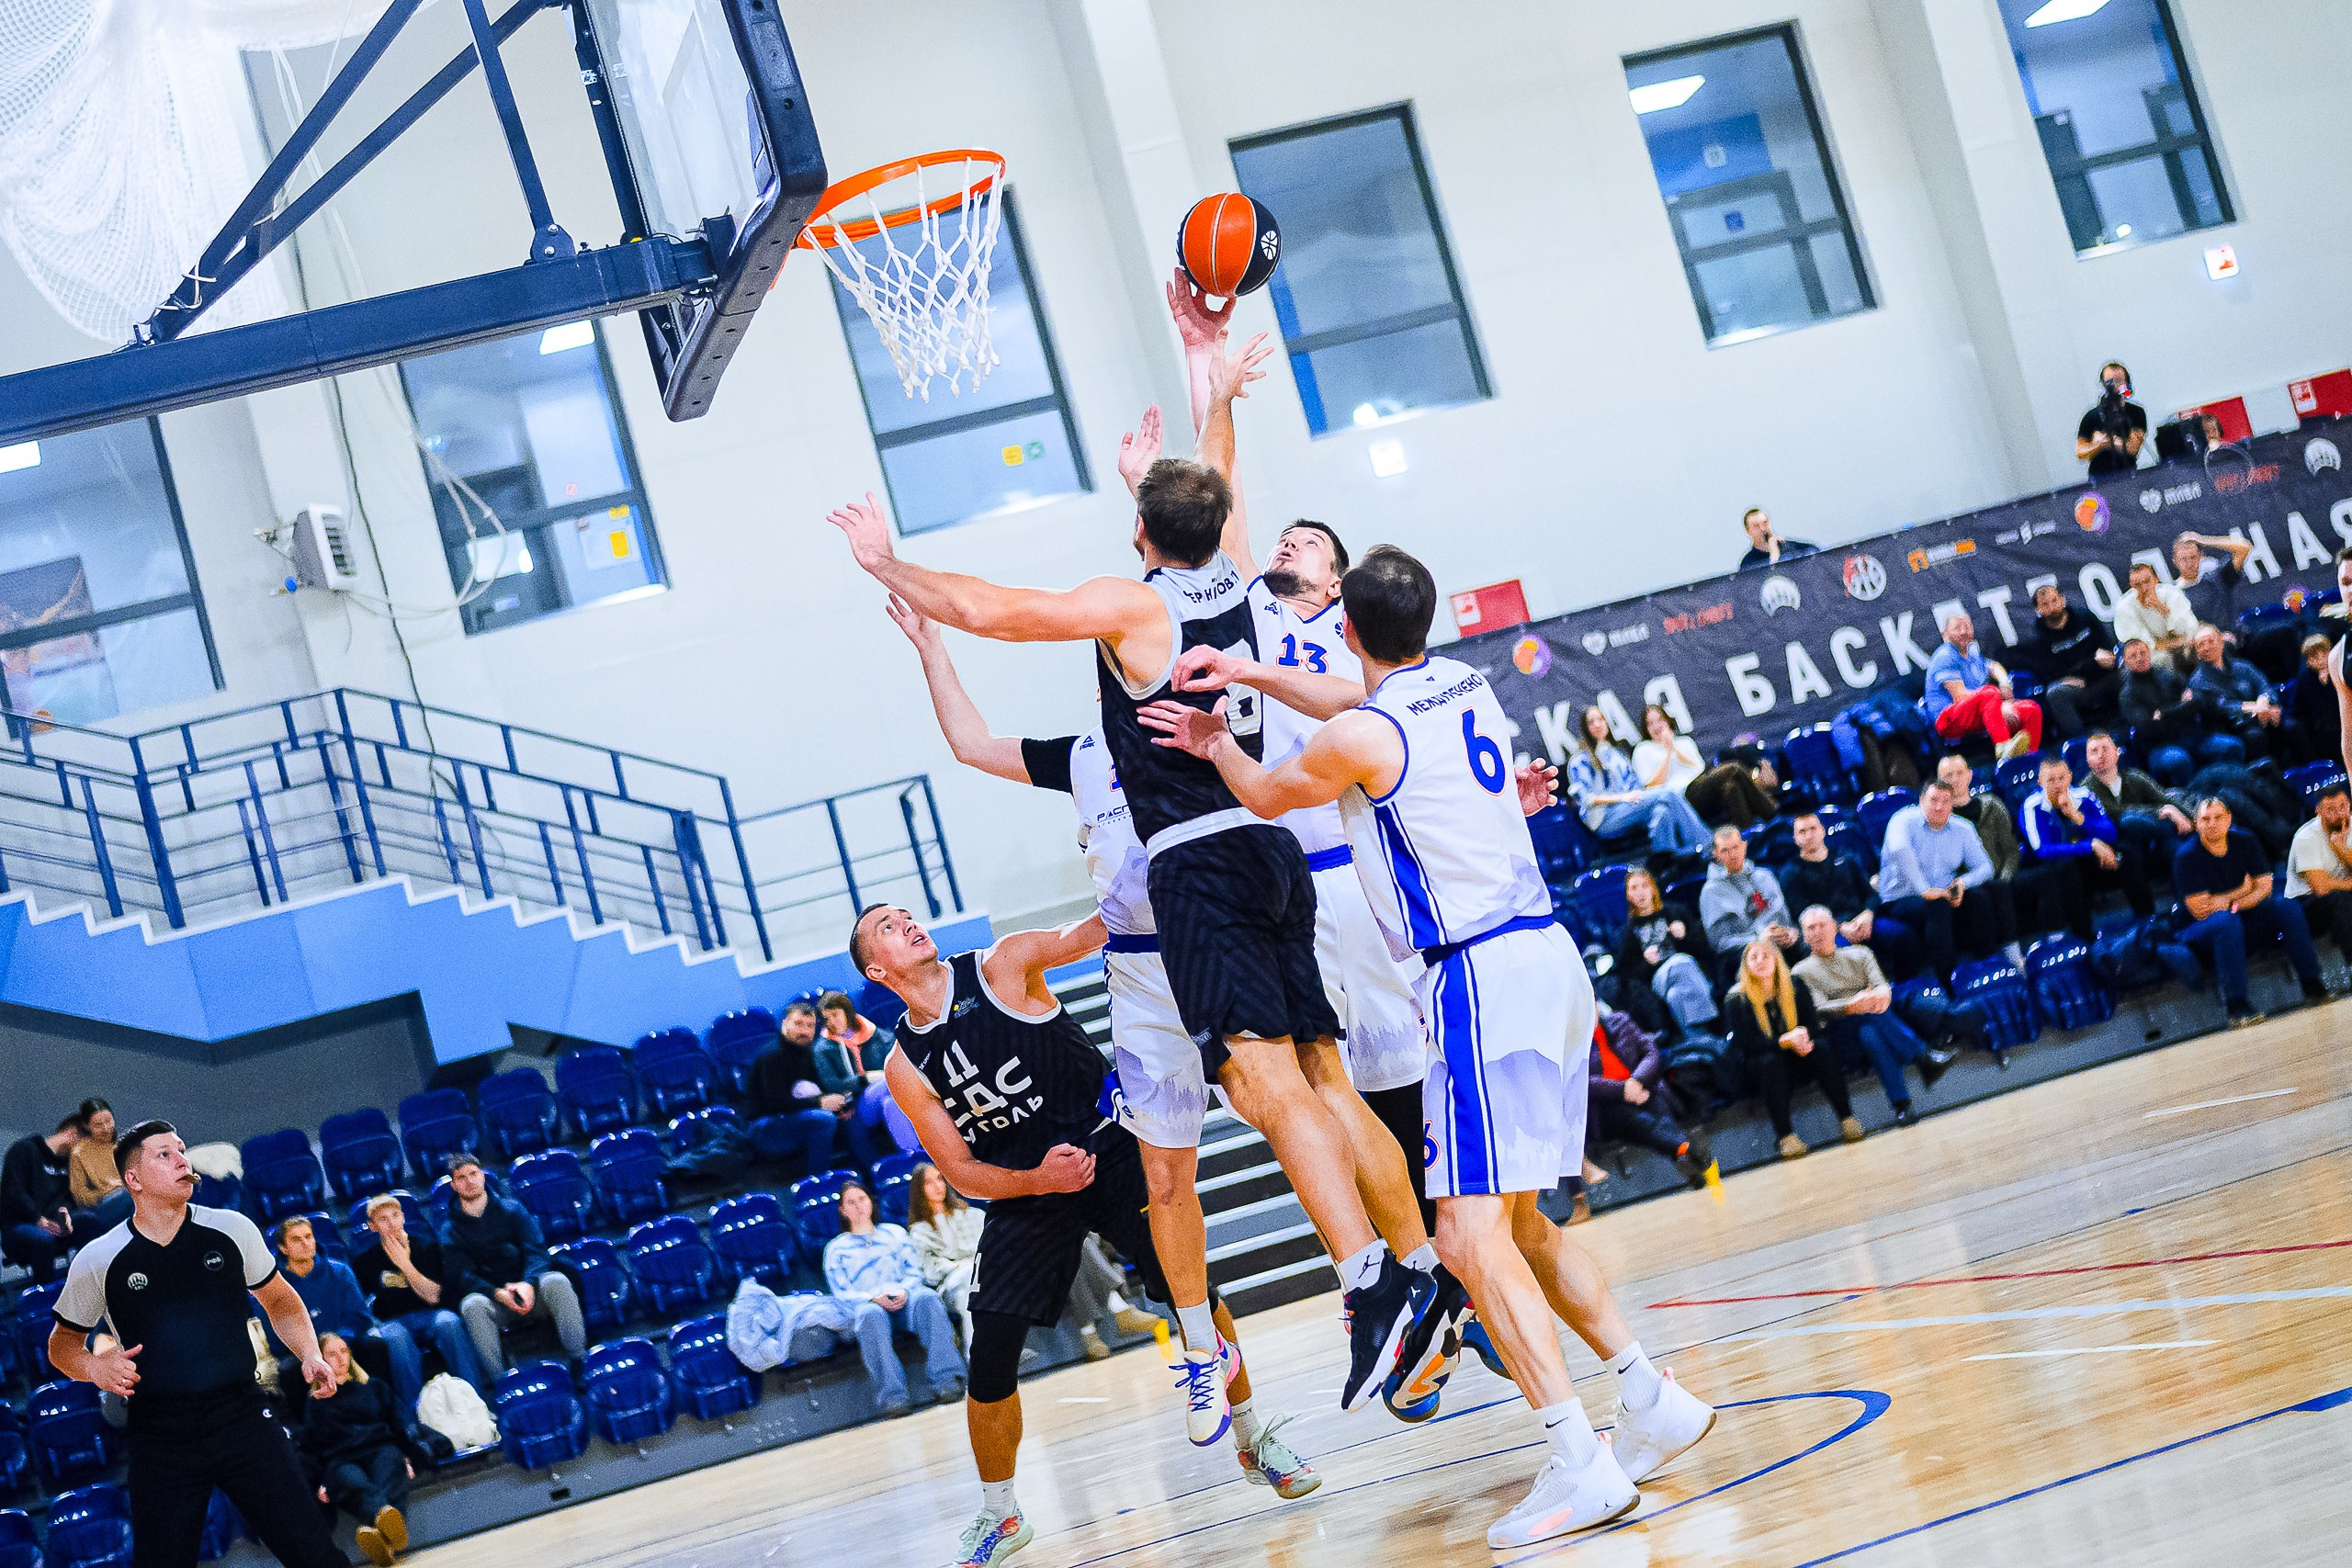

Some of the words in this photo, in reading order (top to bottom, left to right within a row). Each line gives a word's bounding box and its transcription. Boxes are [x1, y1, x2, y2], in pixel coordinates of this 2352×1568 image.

[1276, 631, 1329, 674] 13
[1406, 673, 1484, 716] МЕЖДУРЕЧЕНС
[1507, 673, 1694, 767] КАЯ
[1459, 706, 1507, 796] 6
